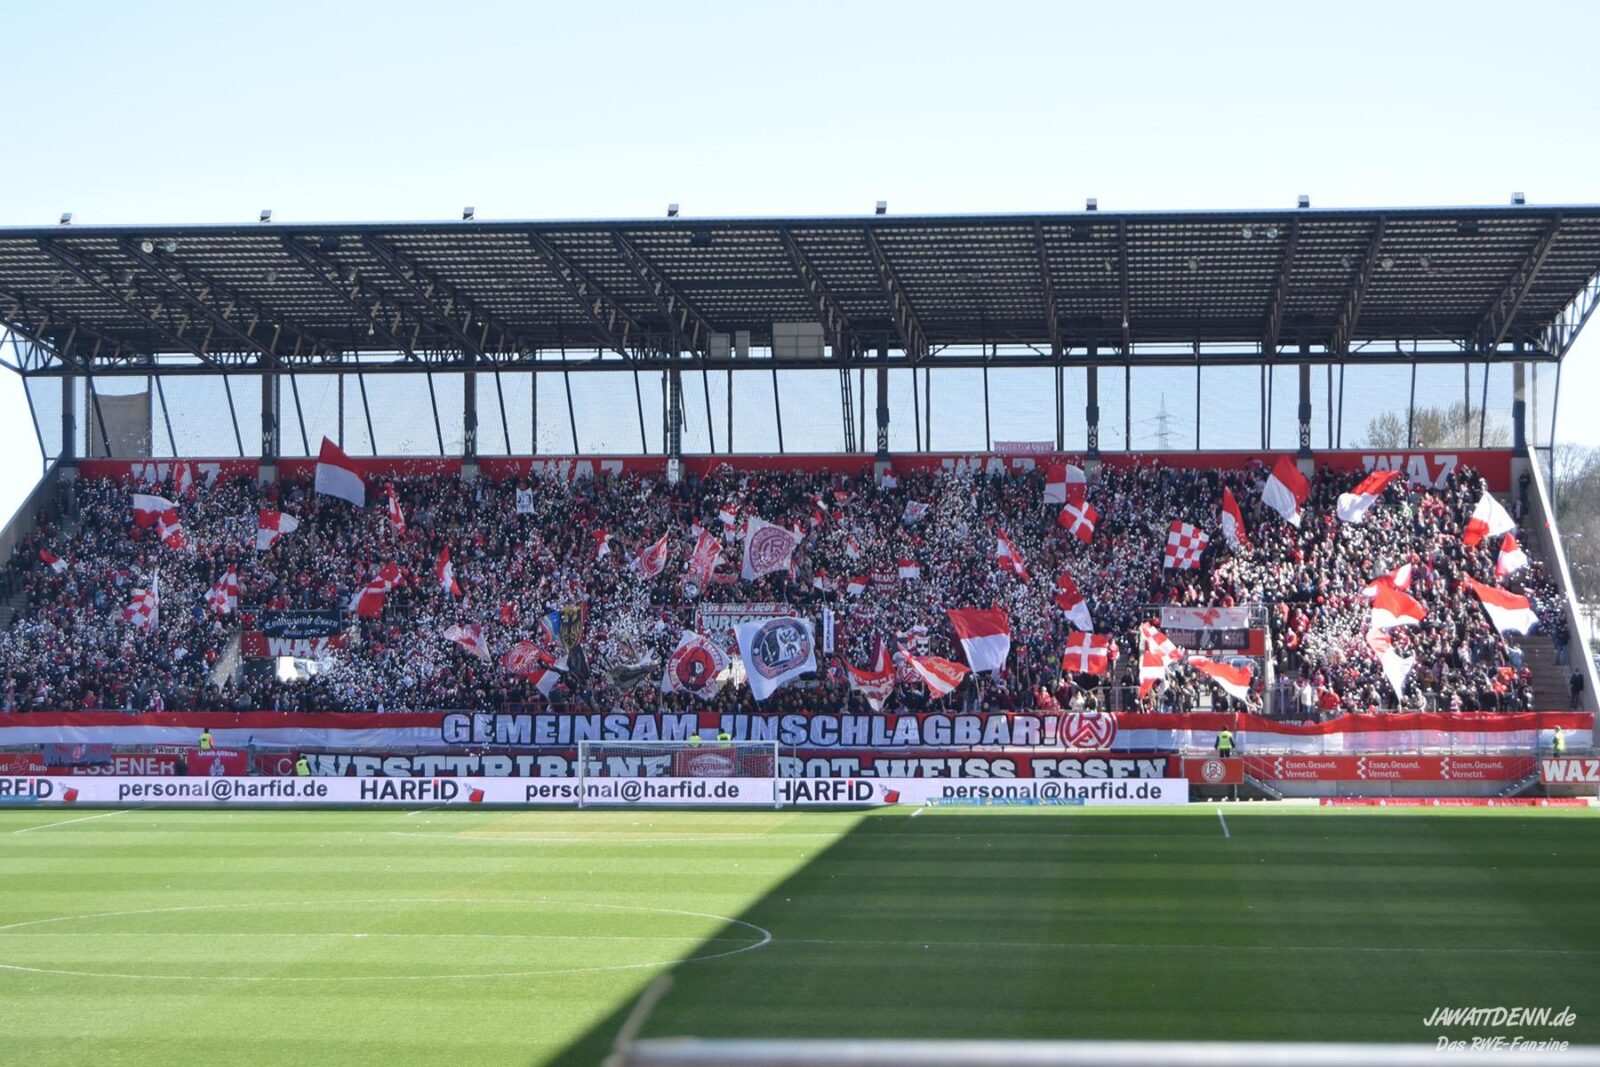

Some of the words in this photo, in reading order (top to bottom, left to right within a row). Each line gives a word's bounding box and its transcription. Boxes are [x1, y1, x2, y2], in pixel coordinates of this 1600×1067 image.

[877, 426, 888, 437] W
[1087, 425, 1098, 434] W
[1299, 423, 1310, 433] W
[262, 432, 272, 441] W
[465, 430, 475, 439] W
[1301, 434, 1310, 446] 3
[467, 442, 472, 451] 1
[879, 437, 887, 450] 2
[1089, 435, 1097, 448] 3
[264, 443, 270, 452] 1
[1362, 455, 1457, 491] WAZ
[442, 714, 698, 745] GEMEINSAM
[720, 714, 1058, 747] UNSCHLAGBAR!
[778, 757, 1015, 778] ROT-WEISS
[1031, 758, 1167, 778] ESSEN
[1542, 760, 1600, 783] WAZ
[1285, 770, 1318, 778] Vernetzt.
[1368, 770, 1401, 778] Vernetzt.
[1452, 770, 1485, 779] Vernetzt.
[118, 779, 328, 802] personal@harfid.de
[526, 780, 739, 802] personal@harfid.de
[942, 781, 1162, 800] personal@harfid.de
